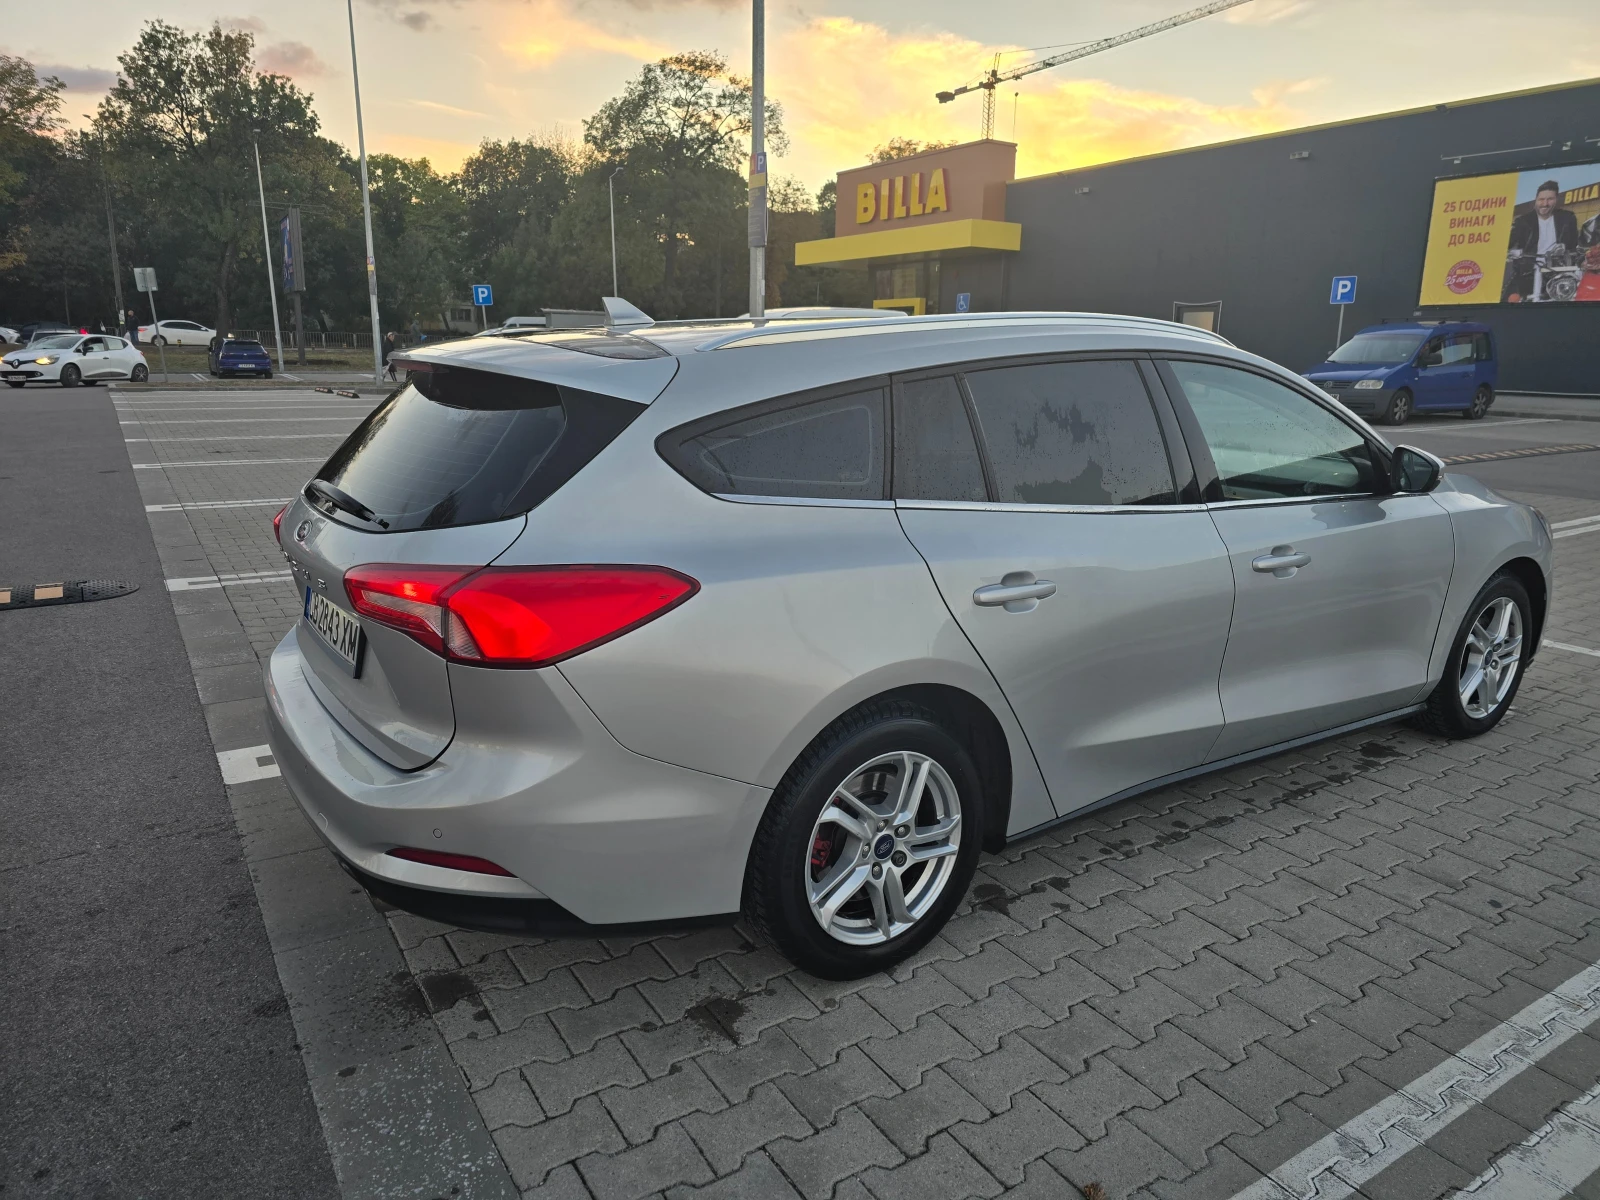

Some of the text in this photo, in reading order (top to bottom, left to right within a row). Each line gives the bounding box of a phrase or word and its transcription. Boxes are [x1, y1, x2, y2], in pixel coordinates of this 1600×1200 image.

[856, 167, 948, 224] BILLA
[1564, 184, 1599, 205] BILLA
[1443, 196, 1507, 214] 25 ГОДИНИ
[1449, 215, 1495, 229] ВИНАГИ
[1447, 232, 1491, 247] ДО ВАС
[478, 287, 488, 303] P
[1336, 280, 1351, 300] P
